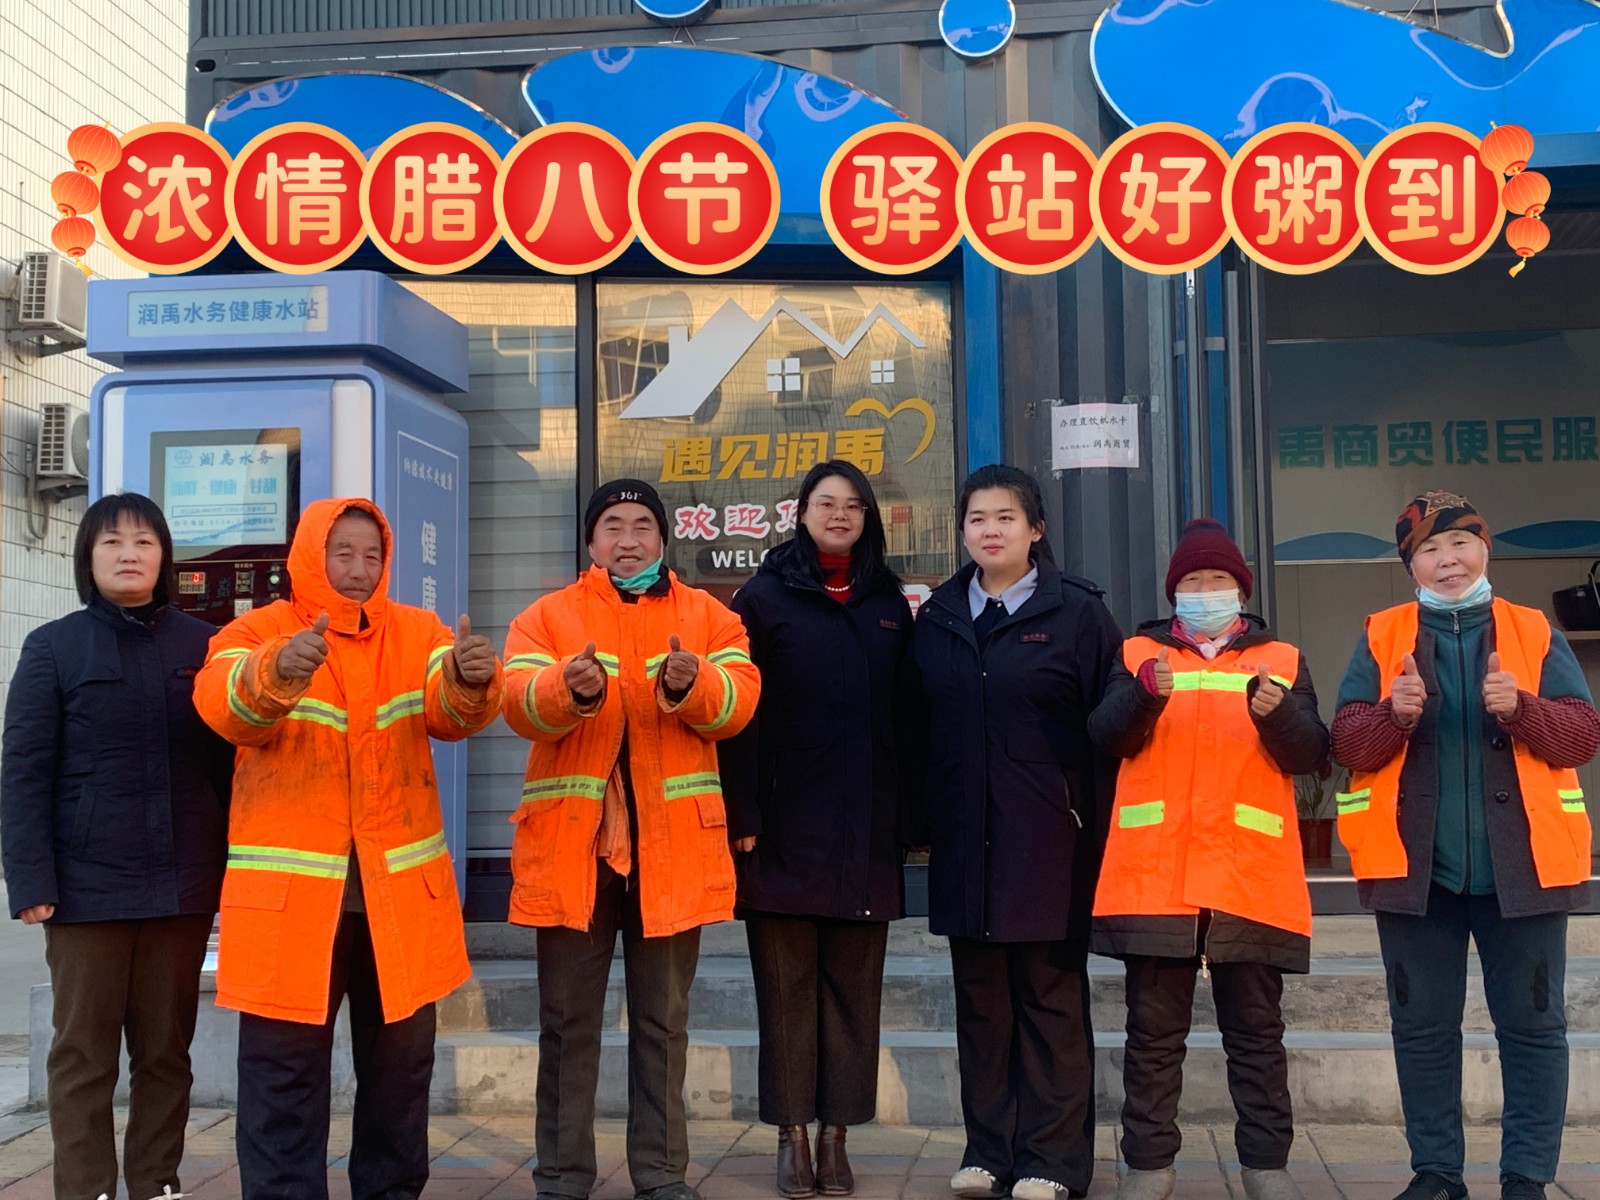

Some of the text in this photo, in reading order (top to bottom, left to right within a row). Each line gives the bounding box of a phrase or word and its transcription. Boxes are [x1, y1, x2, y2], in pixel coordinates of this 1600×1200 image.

[137, 297, 320, 325] 润禹水务健康水站
[659, 428, 885, 483] 遇见润禹
